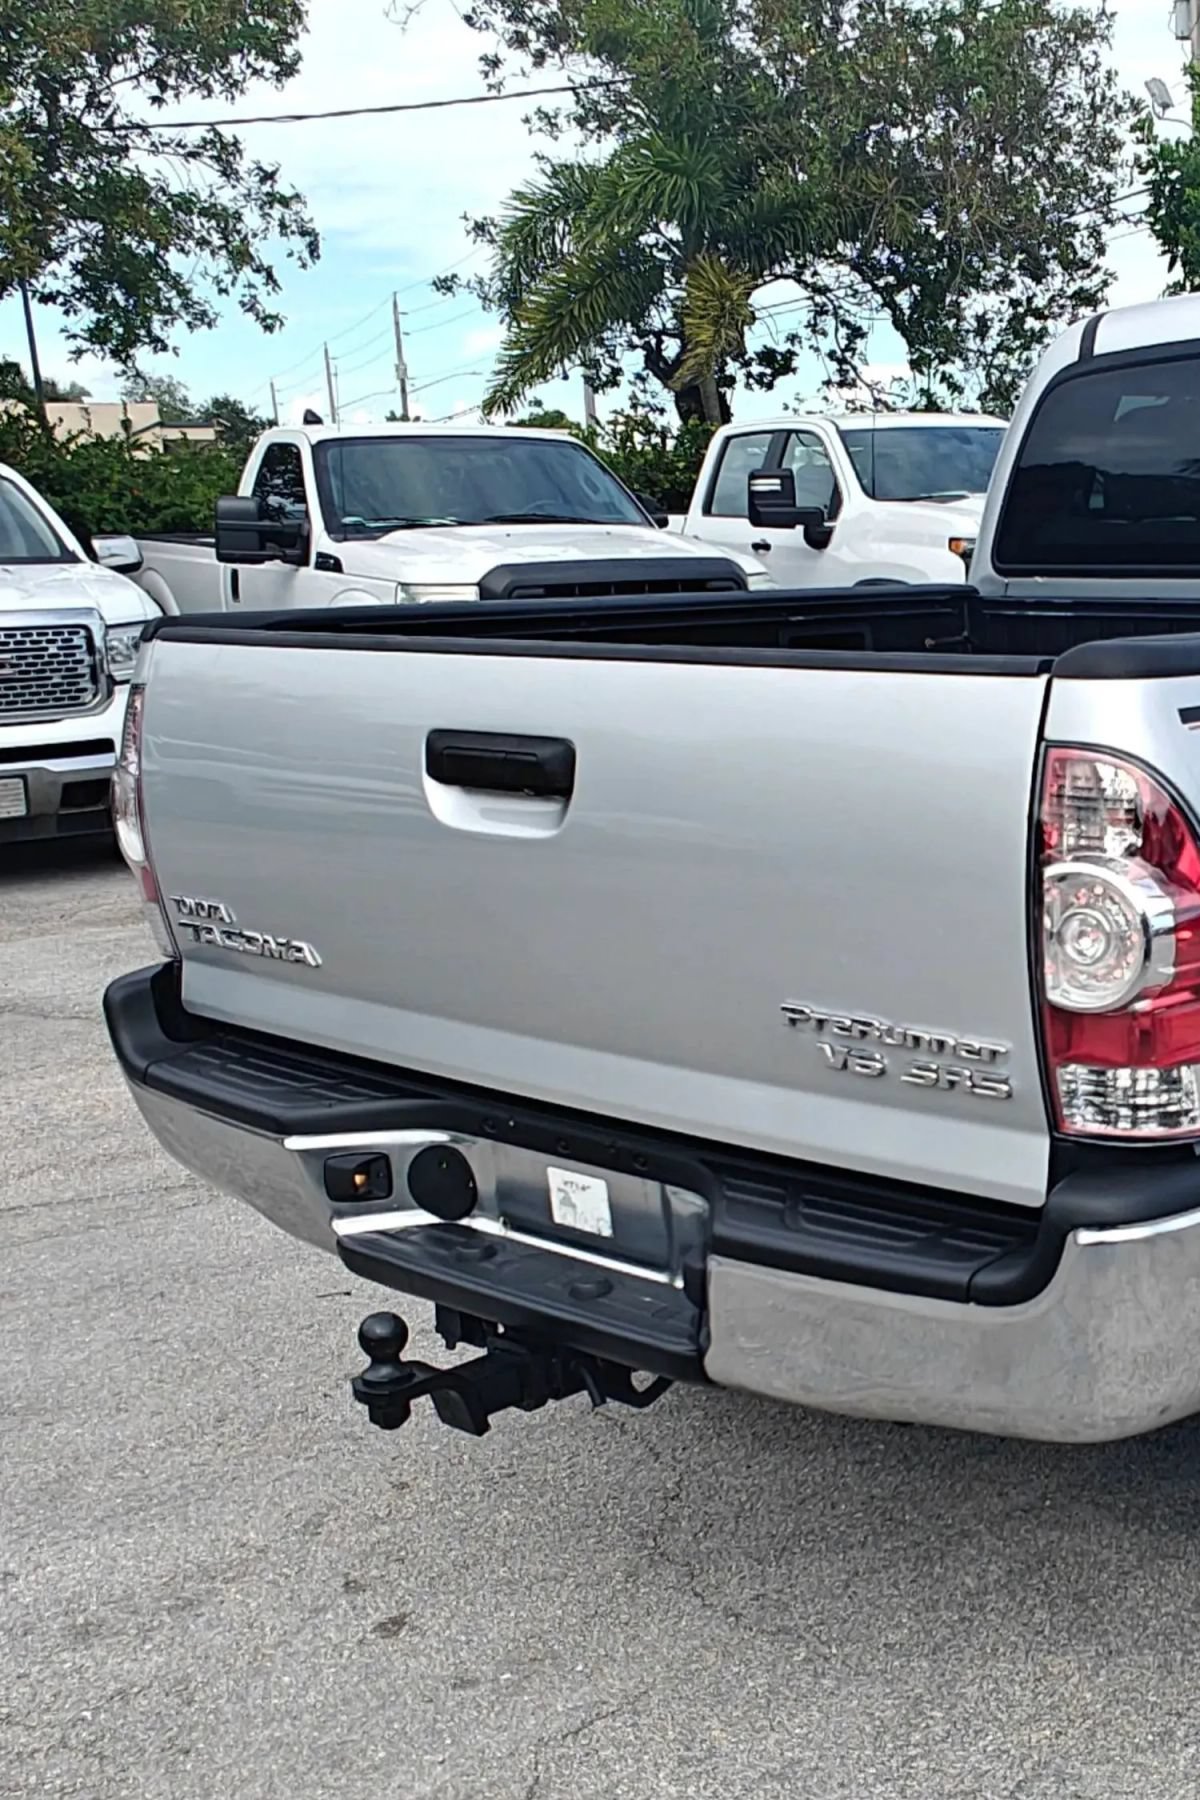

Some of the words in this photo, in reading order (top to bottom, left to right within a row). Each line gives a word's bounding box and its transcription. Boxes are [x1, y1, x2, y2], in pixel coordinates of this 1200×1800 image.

[177, 919, 323, 969] TACOMA
[815, 1041, 887, 1078] V6
[900, 1058, 1014, 1099] SR5
